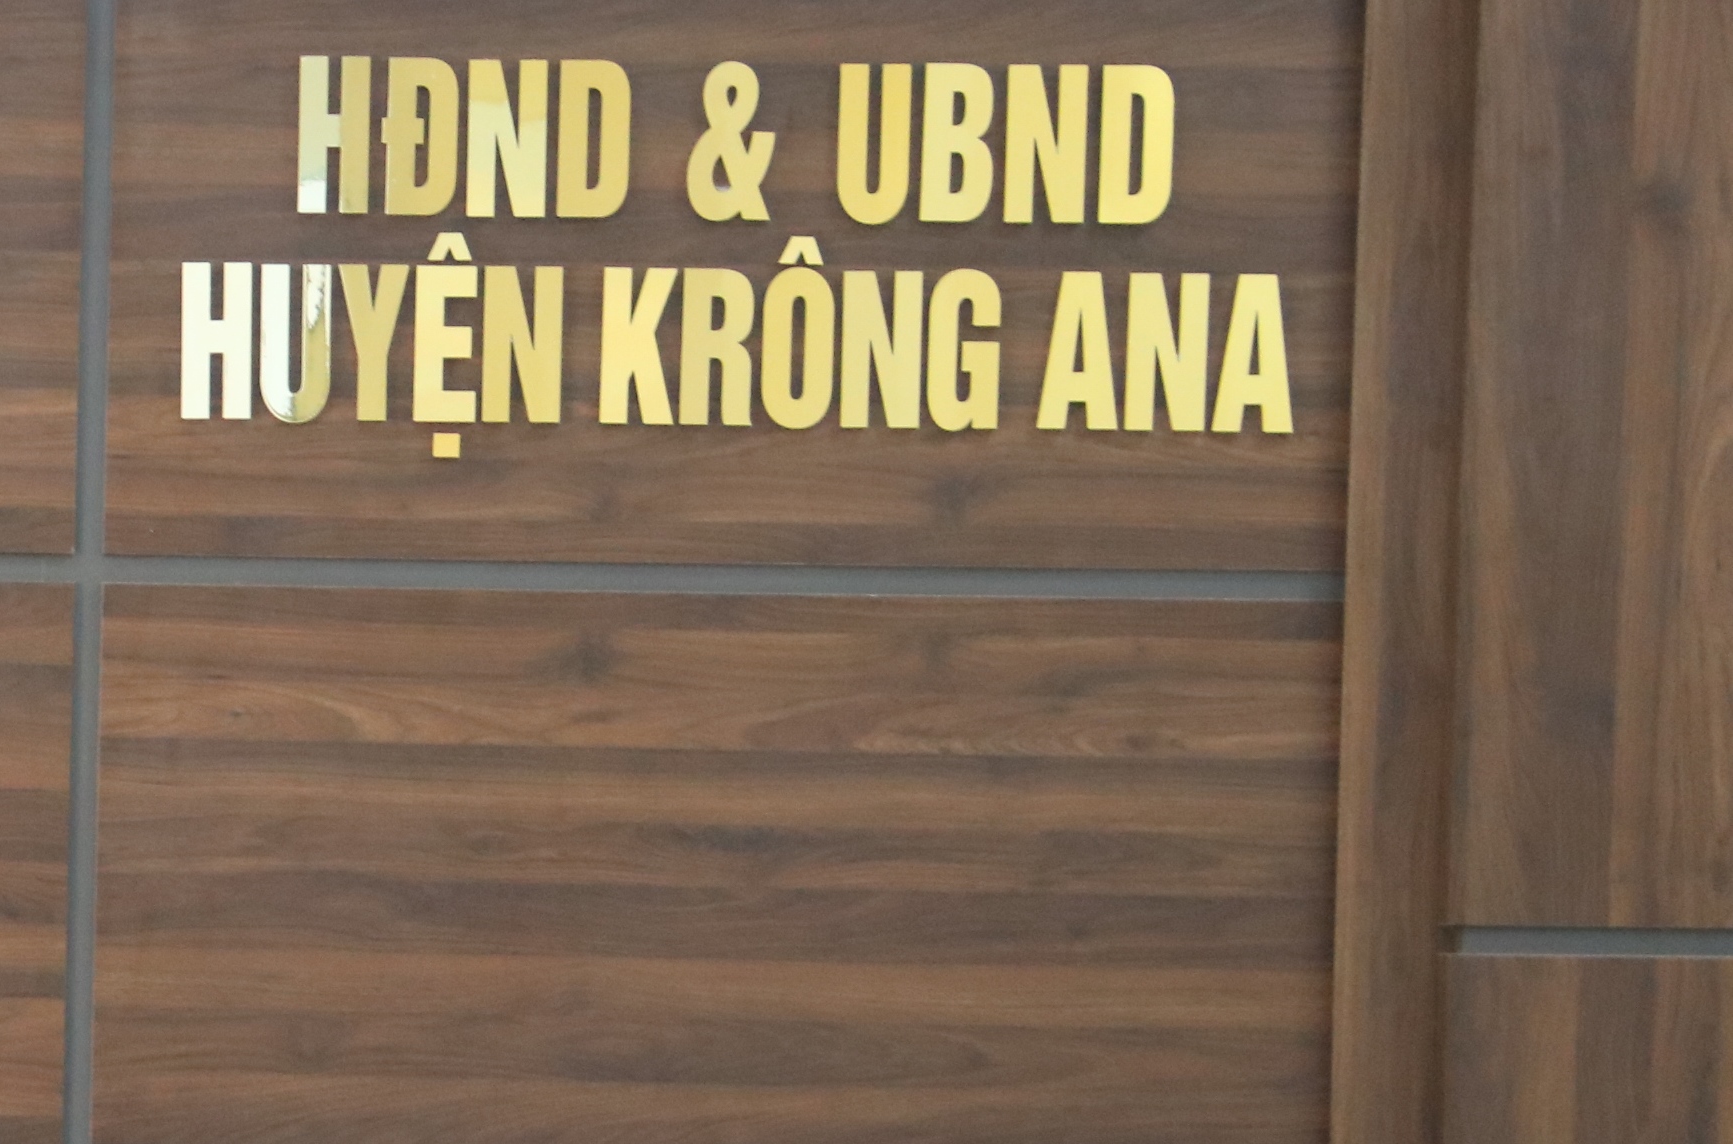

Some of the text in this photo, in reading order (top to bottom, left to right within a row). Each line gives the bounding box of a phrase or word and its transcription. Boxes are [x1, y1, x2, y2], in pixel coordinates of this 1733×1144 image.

[297, 55, 1176, 225] HĐND & UBND
[180, 232, 1293, 458] HUYỆN KRÔNG ANA
